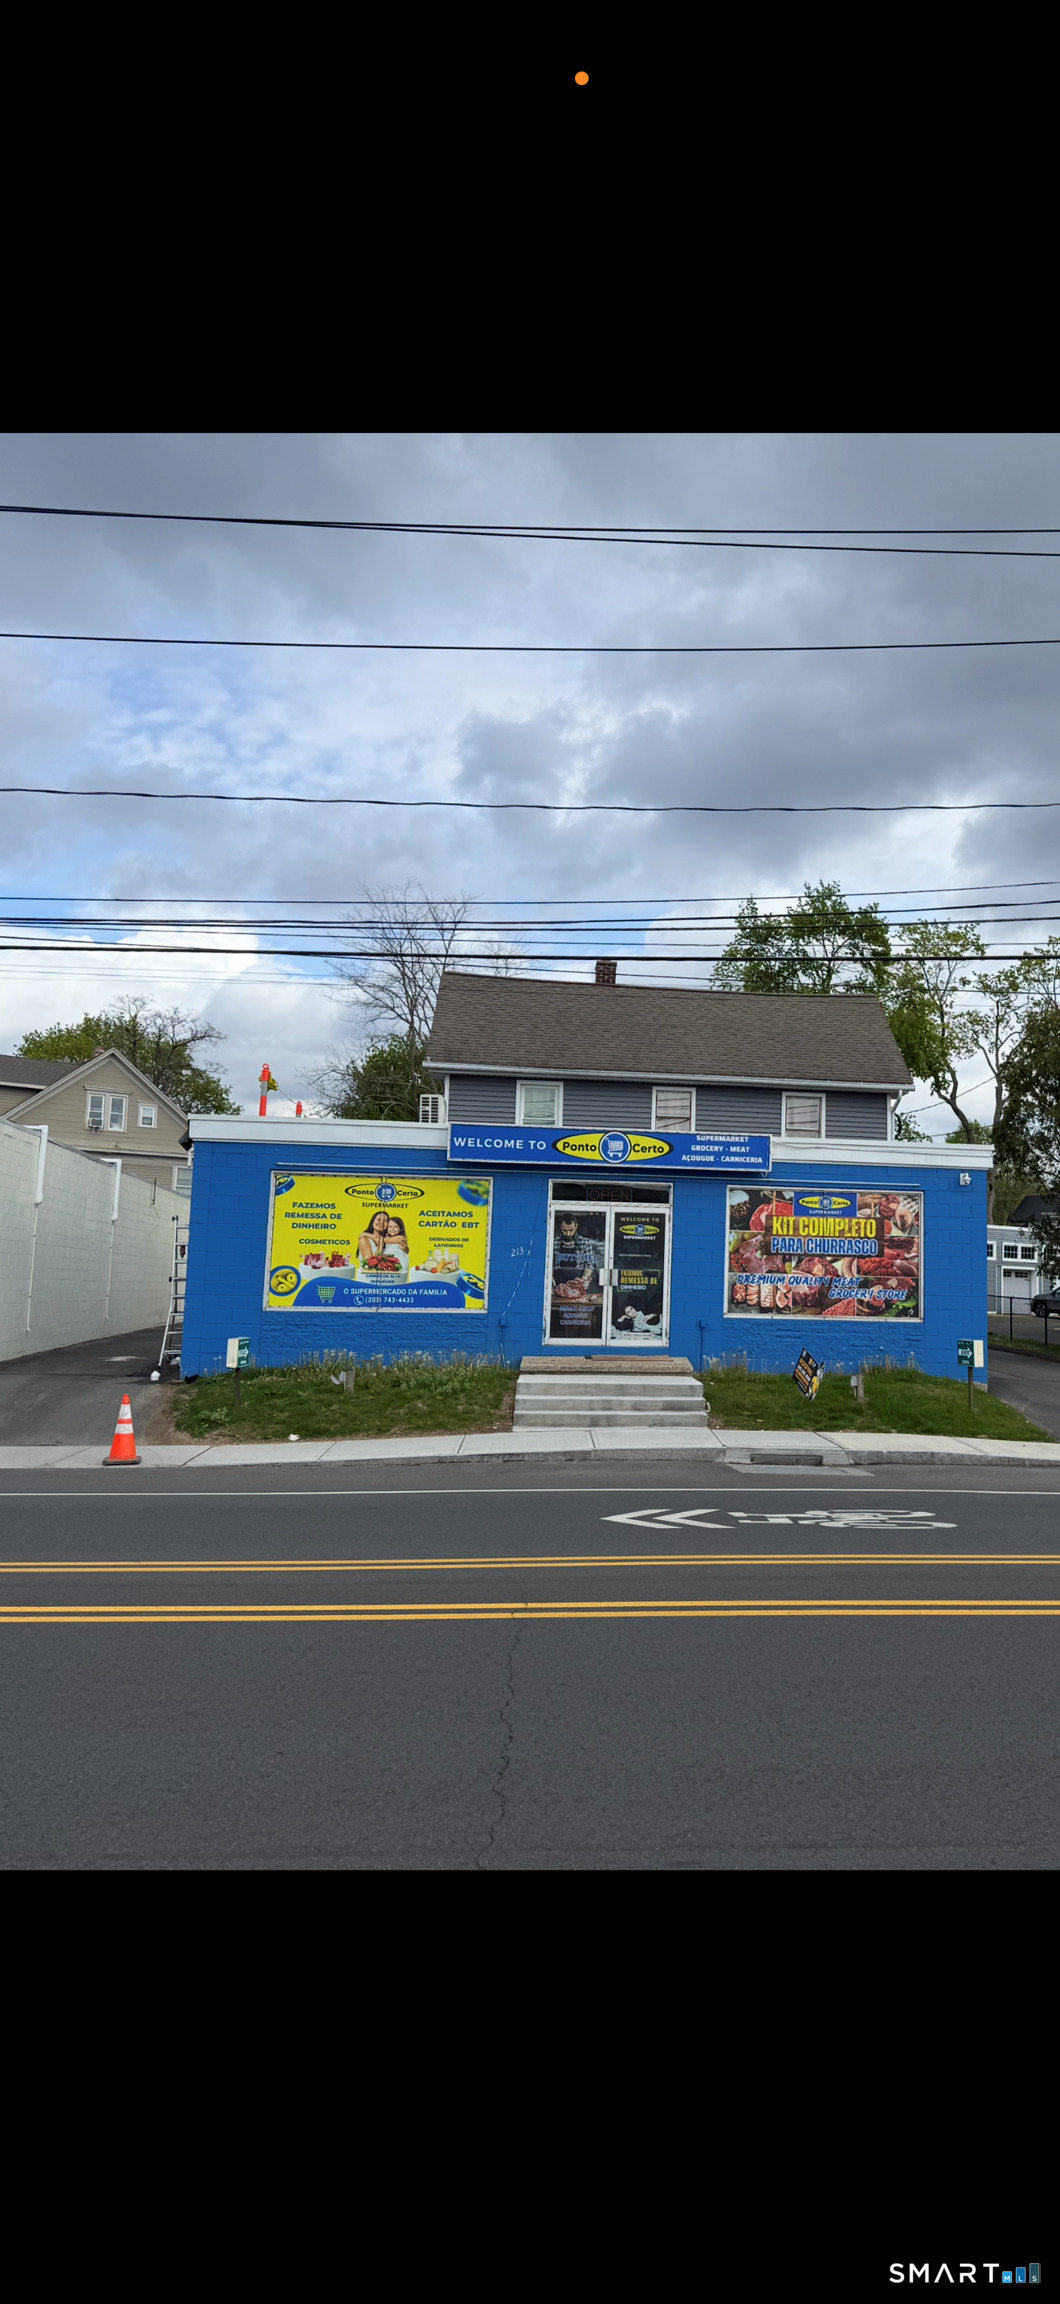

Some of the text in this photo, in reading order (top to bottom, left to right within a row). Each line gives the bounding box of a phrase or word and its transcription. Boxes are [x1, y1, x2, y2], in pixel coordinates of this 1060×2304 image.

[453, 1137, 546, 1150] WELCOME TO
[696, 1134, 750, 1142] SUPERMARKET
[562, 1142, 664, 1154] Ponto Certo
[589, 1190, 630, 1202] OPEN
[772, 1216, 876, 1238] KIT COMPLETO
[511, 1247, 524, 1257] 213
[771, 1237, 878, 1255] PARA CHURRASCO
[737, 1274, 862, 1287] PREMIUM QUALITY MEAT
[828, 1289, 908, 1300] GROCERY STORE
